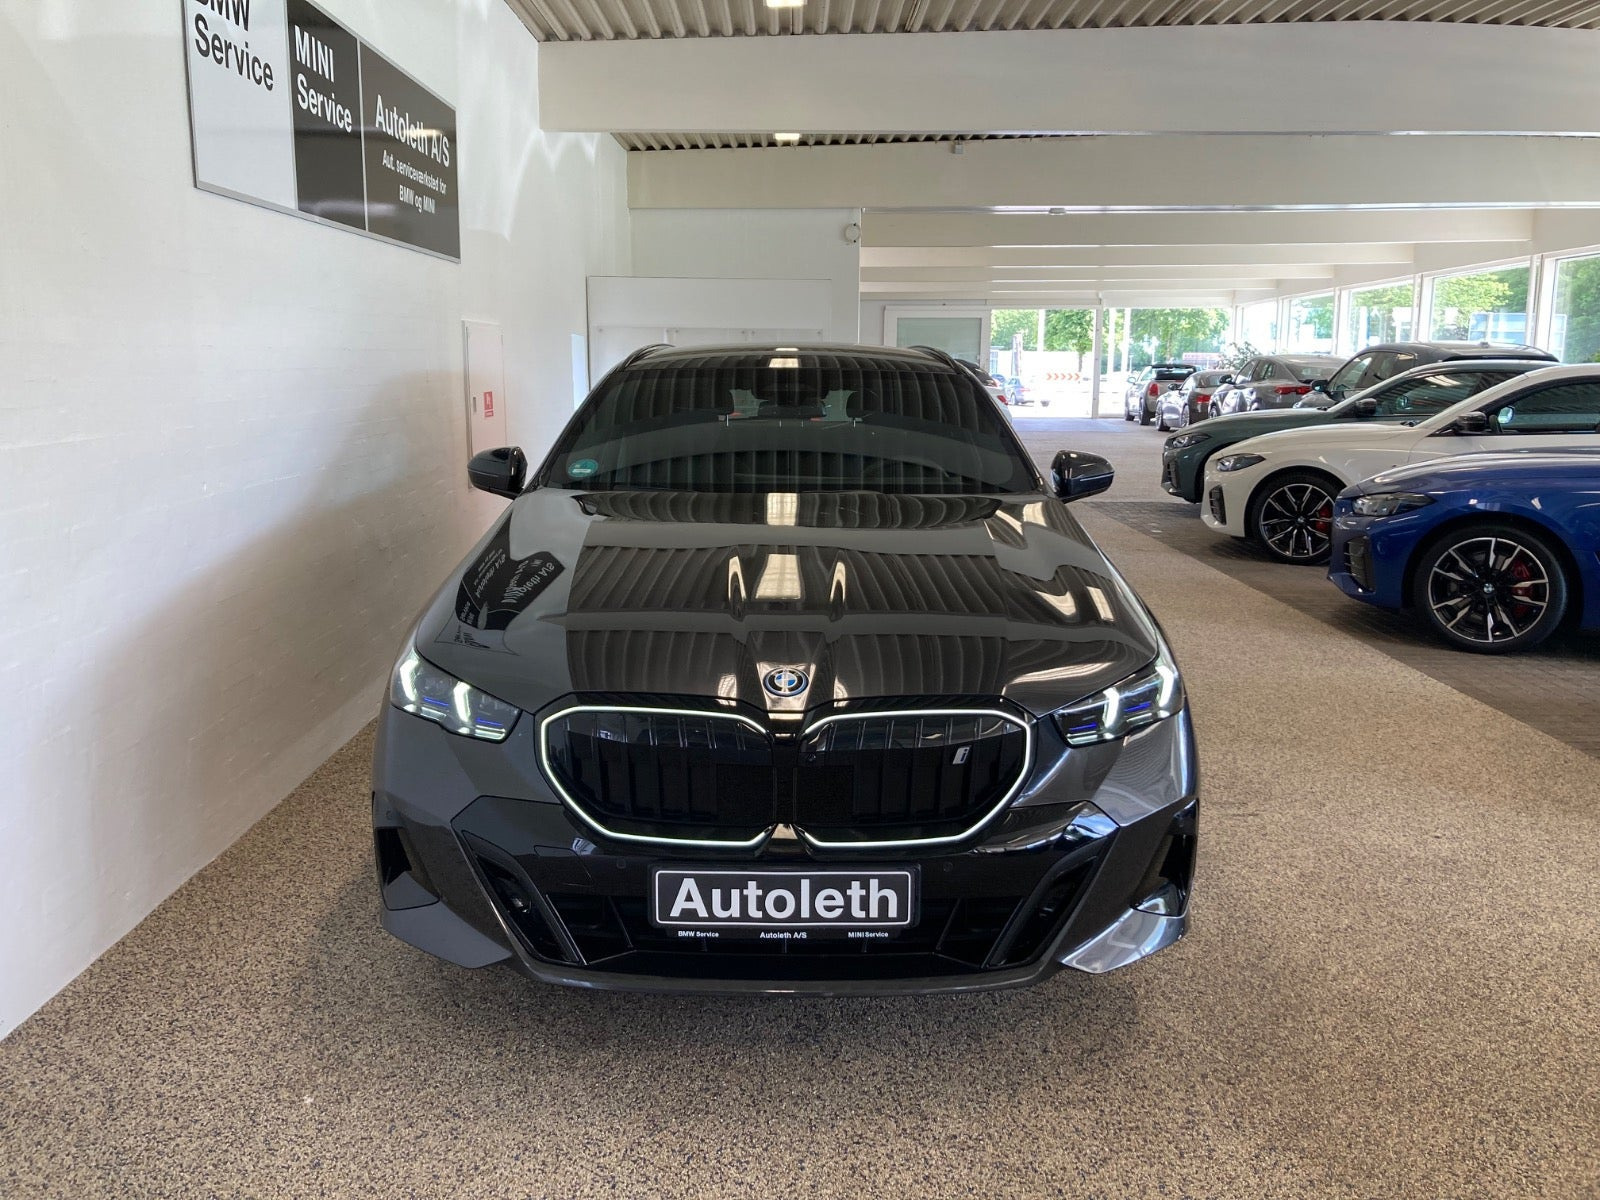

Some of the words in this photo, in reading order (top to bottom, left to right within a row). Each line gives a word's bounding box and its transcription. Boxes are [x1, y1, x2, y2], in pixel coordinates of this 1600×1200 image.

[194, 13, 274, 91] Service
[294, 24, 335, 83] MINI
[297, 72, 353, 133] Service
[375, 94, 428, 156] Autoleth
[431, 129, 450, 168] A/S
[399, 184, 415, 206] BMW
[415, 195, 422, 213] og
[423, 195, 436, 214] MINI
[439, 178, 447, 195] for
[669, 877, 898, 919] Autoleth
[760, 931, 792, 939] Autoleth
[793, 931, 808, 939] A/S
